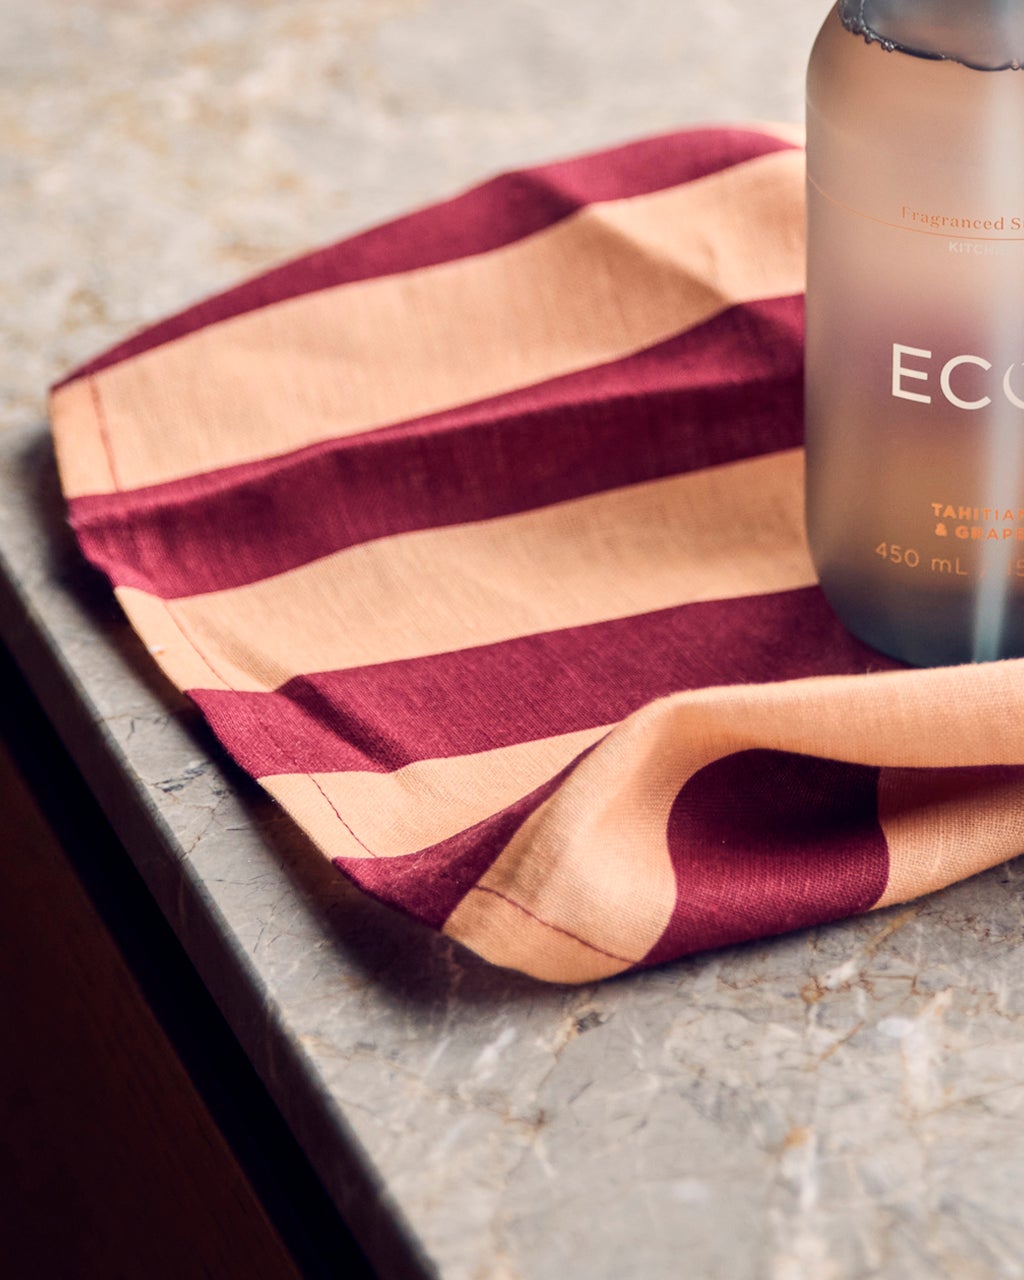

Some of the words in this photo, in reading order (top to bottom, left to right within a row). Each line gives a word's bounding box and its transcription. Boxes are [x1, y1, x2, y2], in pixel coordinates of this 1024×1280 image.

[900, 205, 1005, 231] Fragranced
[933, 522, 949, 537] &
[874, 540, 920, 569] 450
[931, 556, 969, 576] mL
